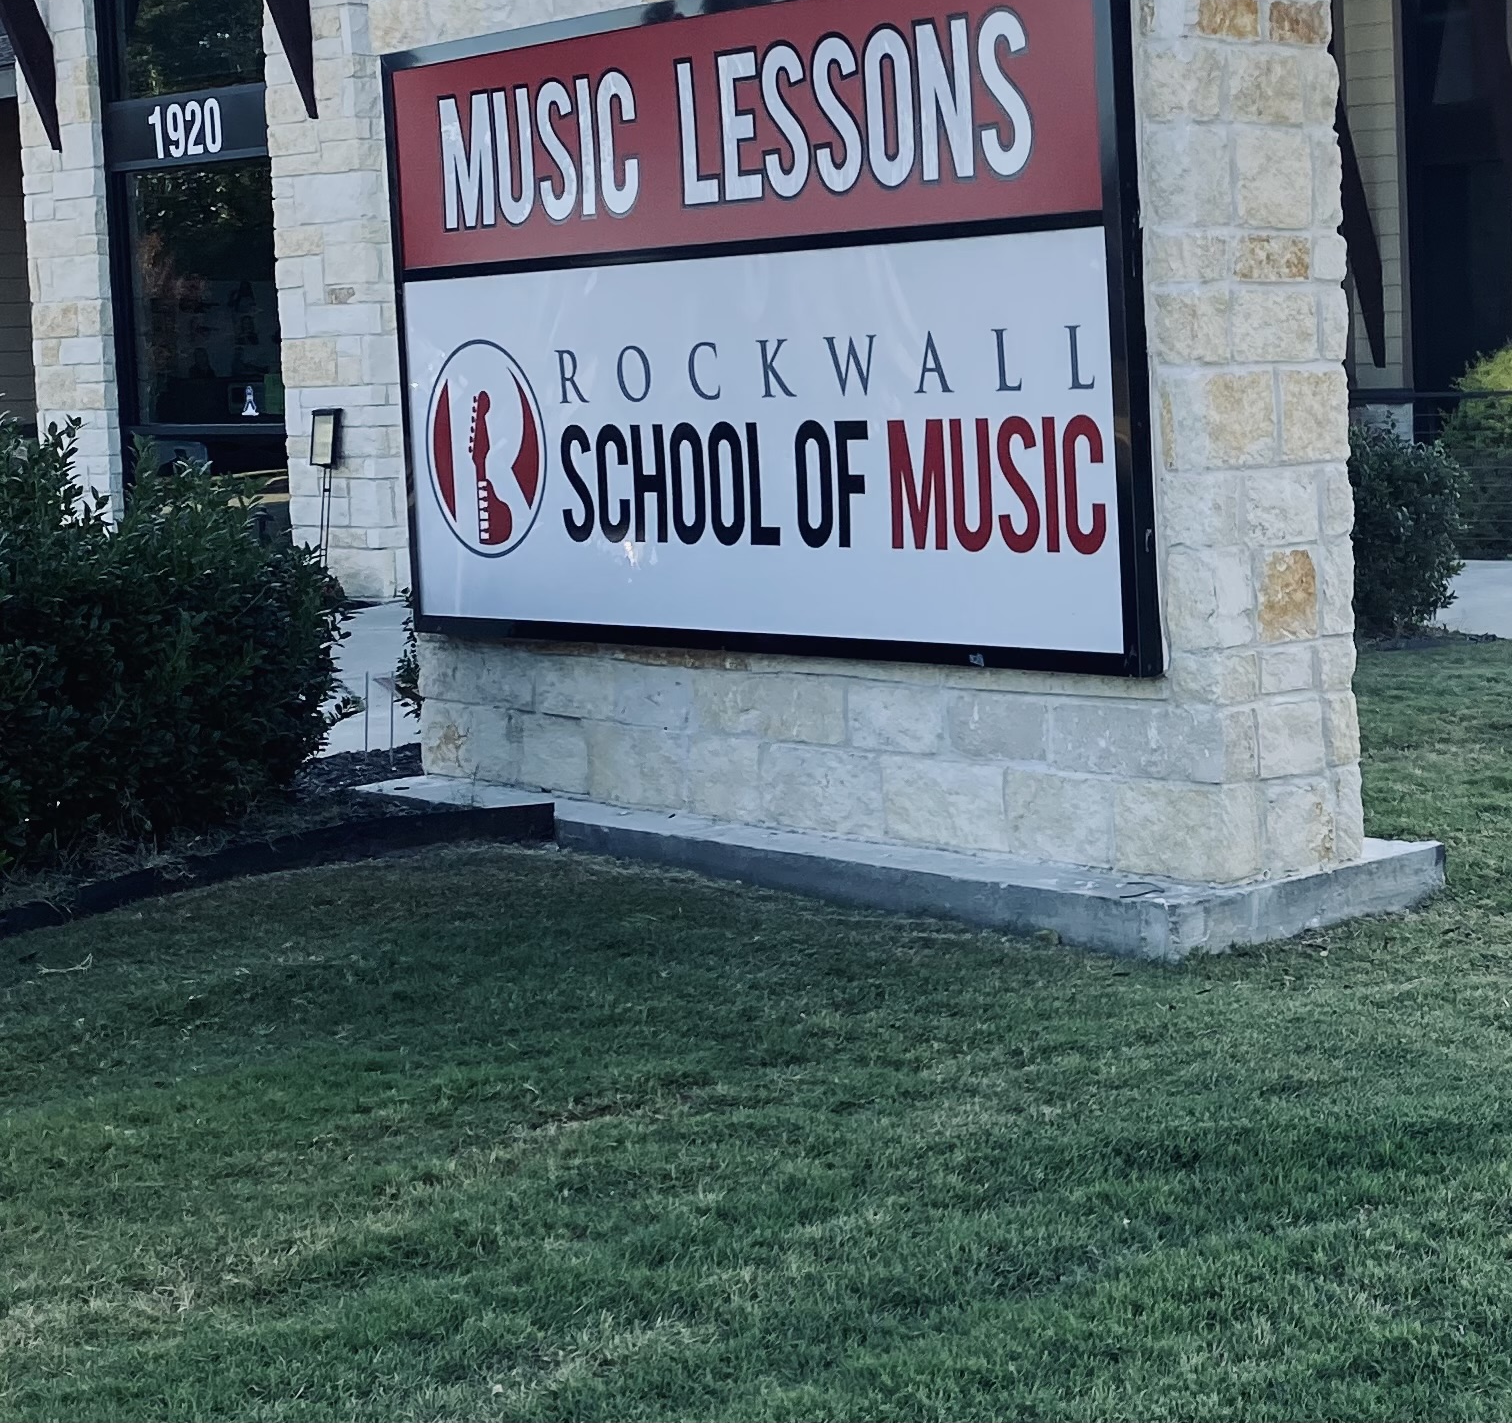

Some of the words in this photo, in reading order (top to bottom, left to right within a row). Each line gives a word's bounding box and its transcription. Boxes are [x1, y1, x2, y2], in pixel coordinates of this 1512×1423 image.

[148, 97, 222, 159] 1920
[437, 67, 640, 234] MUSIC
[673, 5, 1035, 208] LESSONS
[554, 324, 1095, 405] ROCKWALL
[560, 421, 781, 546] SCHOOL
[795, 419, 868, 549] OF
[886, 414, 1107, 555] MUSIC
